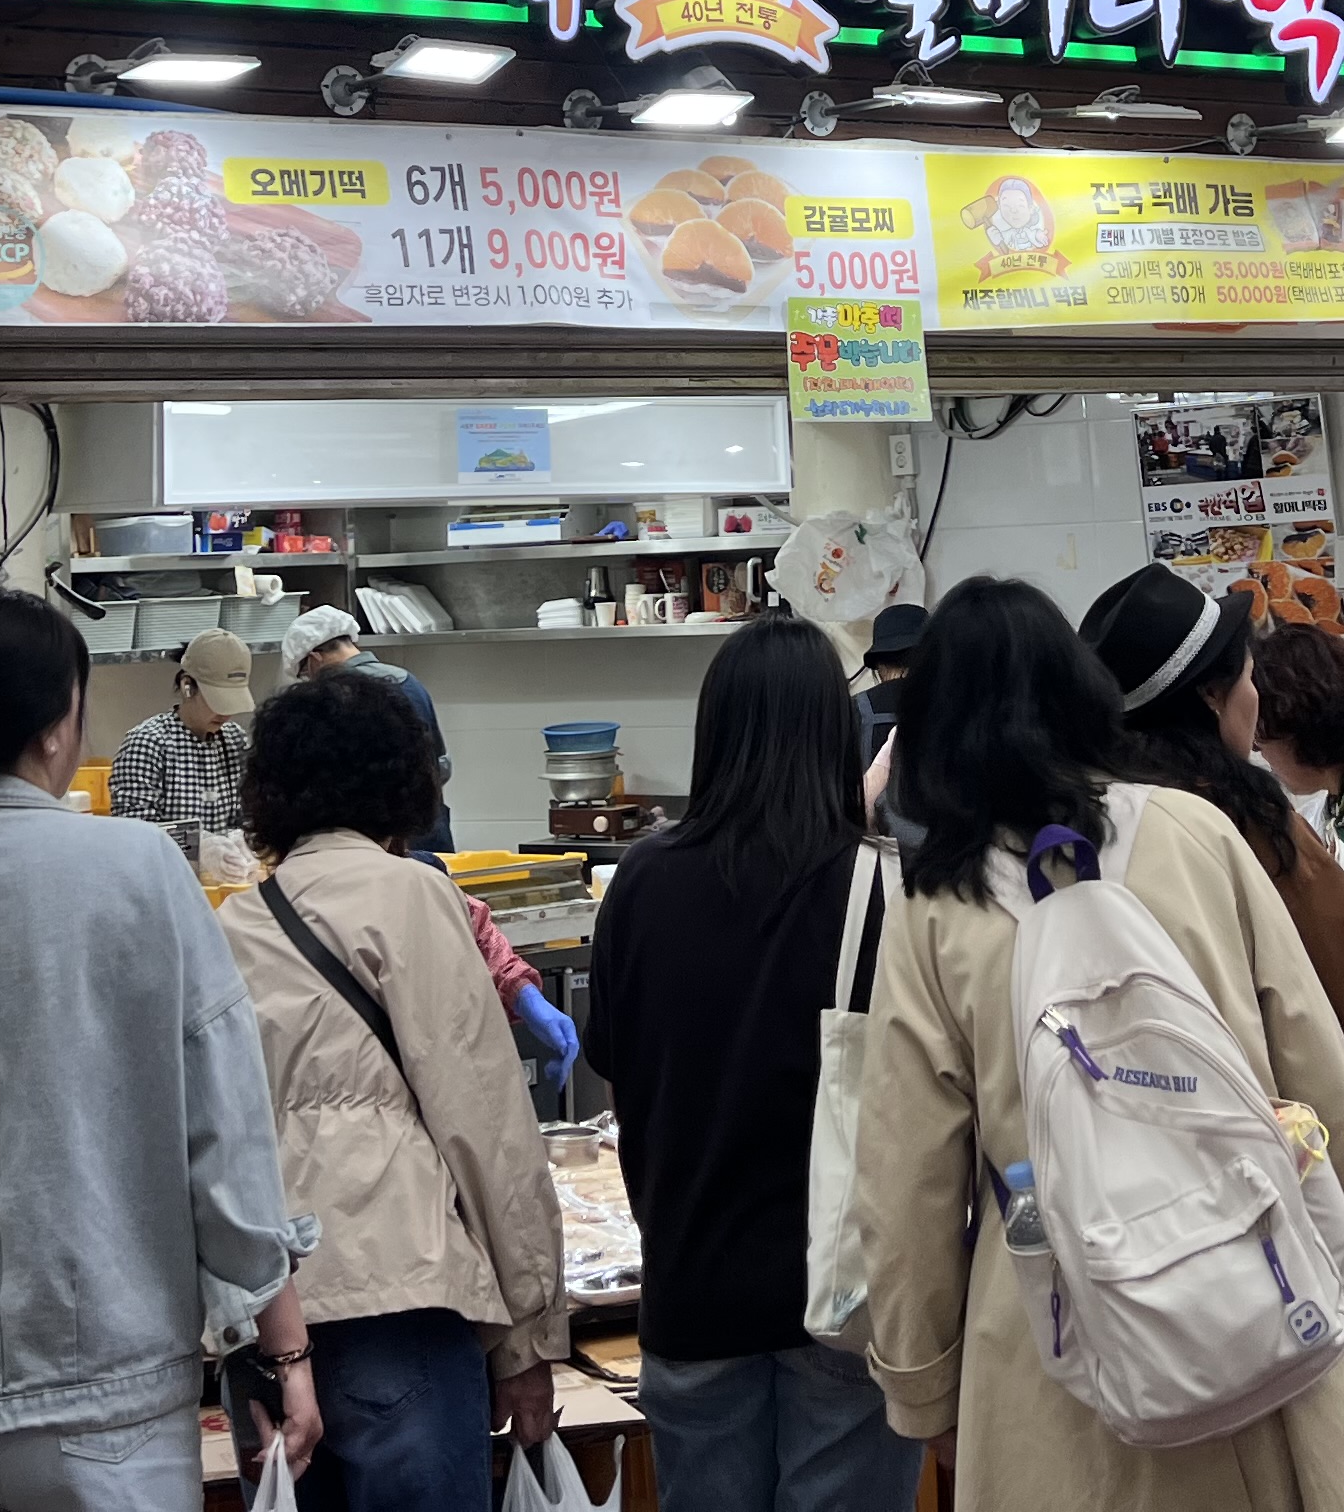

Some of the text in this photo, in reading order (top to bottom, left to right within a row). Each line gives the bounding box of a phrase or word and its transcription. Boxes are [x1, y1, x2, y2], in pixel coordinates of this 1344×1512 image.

[681, 0, 777, 30] 40년 전통
[250, 163, 623, 218] 오메기떡 6개 5,000원
[1090, 181, 1255, 218] 전국 택배 가능
[804, 205, 895, 233] 감귤모찌
[1101, 227, 1261, 247] 택배 시 개별 포장으로 발송
[391, 225, 626, 280] 11개 9,000원
[1000, 254, 1048, 268] 40년 전통
[794, 249, 920, 296] 5,000원
[1101, 261, 1162, 280] 오메기떡
[1167, 260, 1203, 280] 30개
[364, 284, 633, 311] 흑임자로 변경시 1,000원 추가
[962, 285, 1088, 311] 제주할머니 떡집
[1107, 286, 1167, 305] 오메기떡
[1171, 286, 1206, 305] 50개
[1148, 501, 1167, 513] EBS
